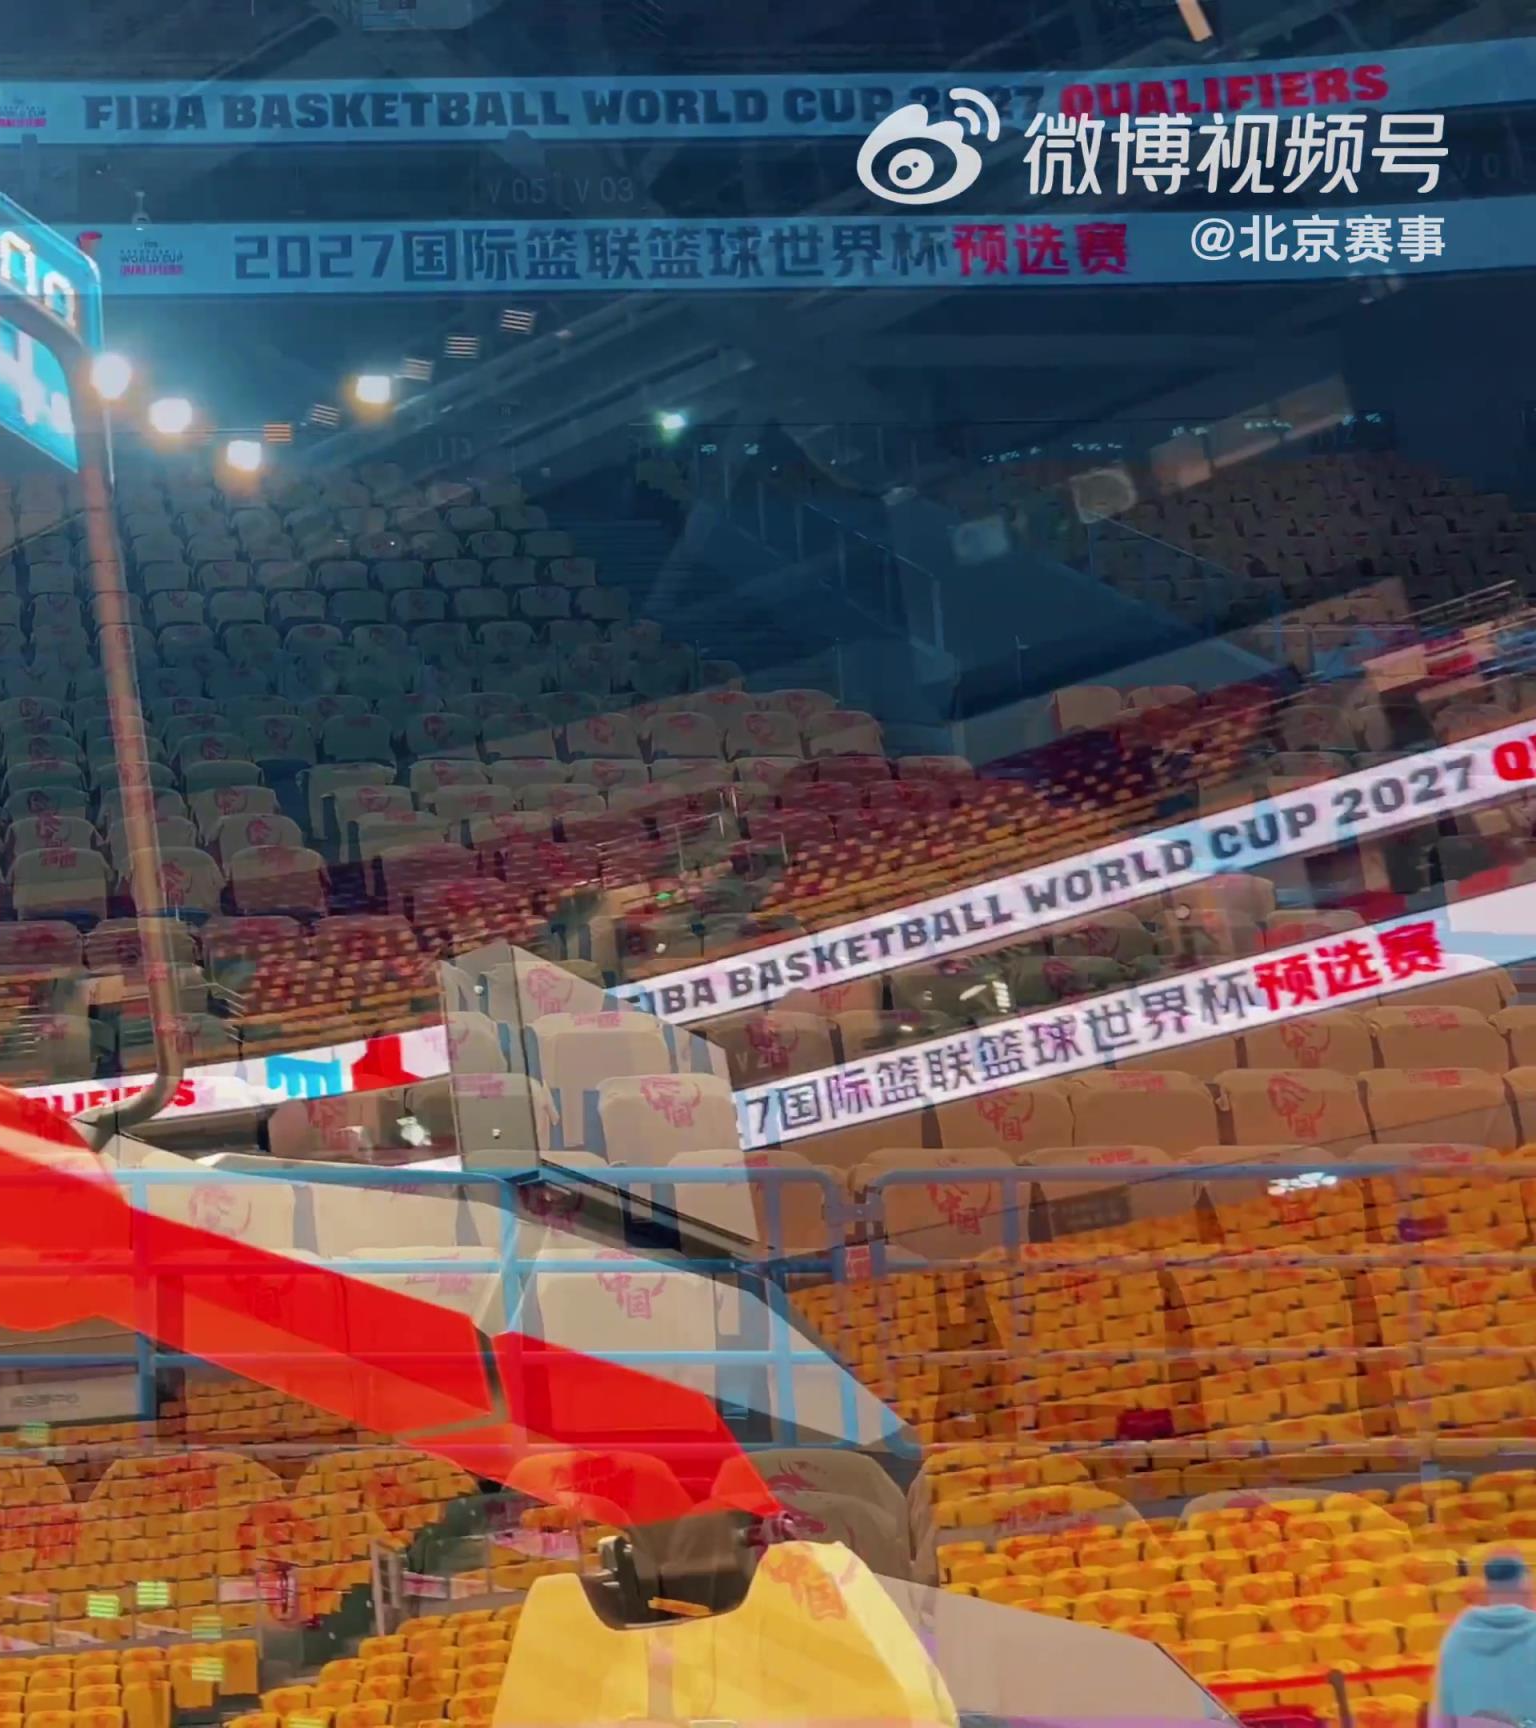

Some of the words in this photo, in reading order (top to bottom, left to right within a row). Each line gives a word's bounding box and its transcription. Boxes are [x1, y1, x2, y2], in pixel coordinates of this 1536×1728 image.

[83, 94, 208, 131] FIBA
[222, 90, 570, 130] BASKETBALL
[581, 88, 768, 126] WORLD
[783, 86, 893, 123] CUP
[1061, 63, 1391, 118] QUALIFIERS
[233, 222, 1132, 284] 2027国际篮联篮球世界杯预选赛
[725, 900, 1014, 999] BASKETBALL
[1026, 838, 1195, 915] WORLD
[1208, 801, 1318, 863] CUP
[1330, 752, 1474, 828] 2027
[736, 917, 1446, 1138] 7国际篮联篮球世界杯预选赛
